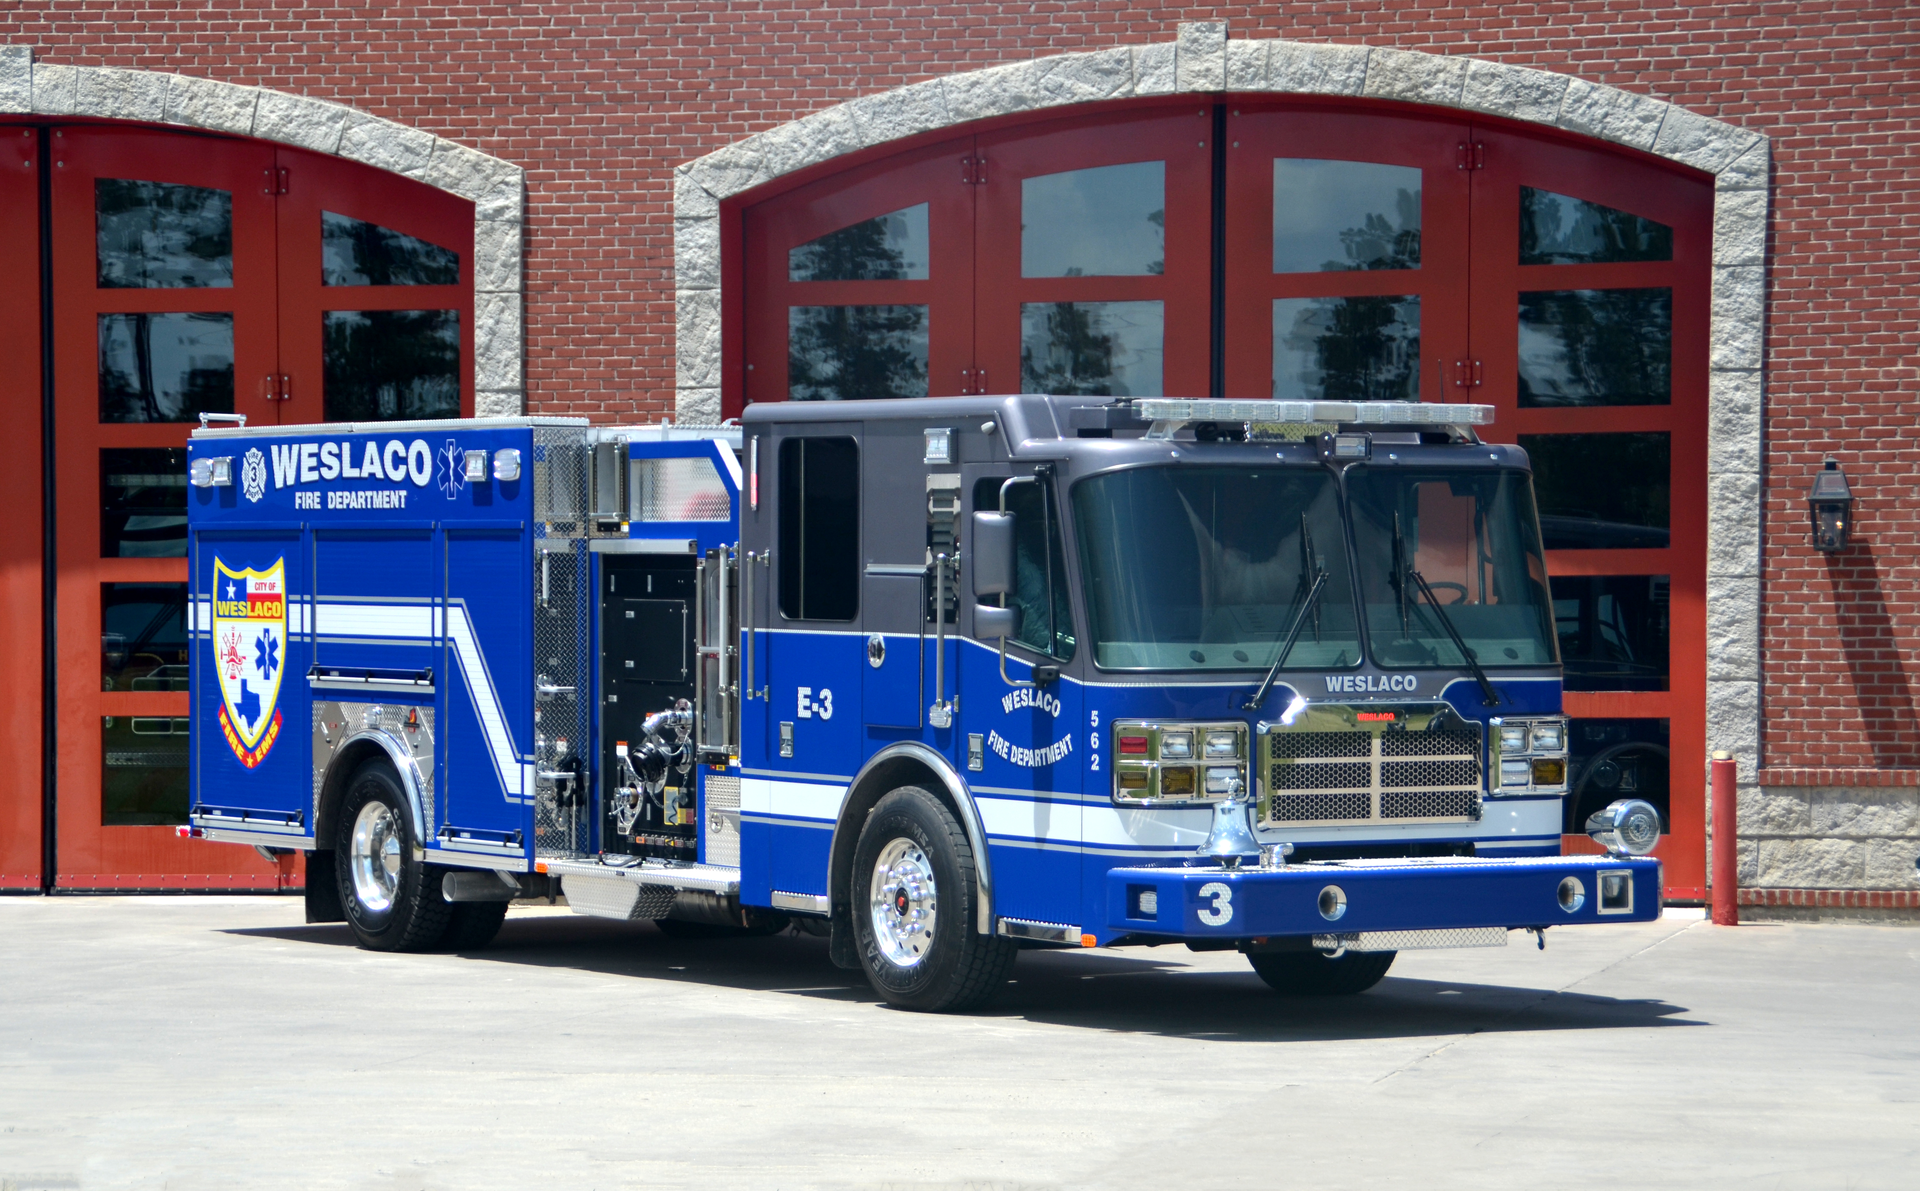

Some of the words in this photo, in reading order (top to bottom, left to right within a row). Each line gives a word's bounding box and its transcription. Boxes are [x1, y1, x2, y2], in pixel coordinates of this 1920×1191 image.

[251, 466, 257, 483] 3
[271, 439, 432, 489] WESLACO
[295, 491, 321, 510] FIRE
[328, 490, 407, 509] DEPARTMENT
[254, 582, 267, 591] CITY
[268, 582, 276, 591] OF
[217, 601, 282, 617] WESLACO
[1325, 675, 1417, 692] WESLACO
[797, 686, 833, 720] E-3
[1001, 688, 1061, 718] WESLACO
[1357, 712, 1395, 721] WESLACO
[219, 712, 245, 760] FIRE
[255, 720, 279, 763] EMS
[987, 729, 1010, 760] FIRE
[1010, 733, 1073, 767] DEPARTMENT
[1197, 882, 1233, 926] 3
